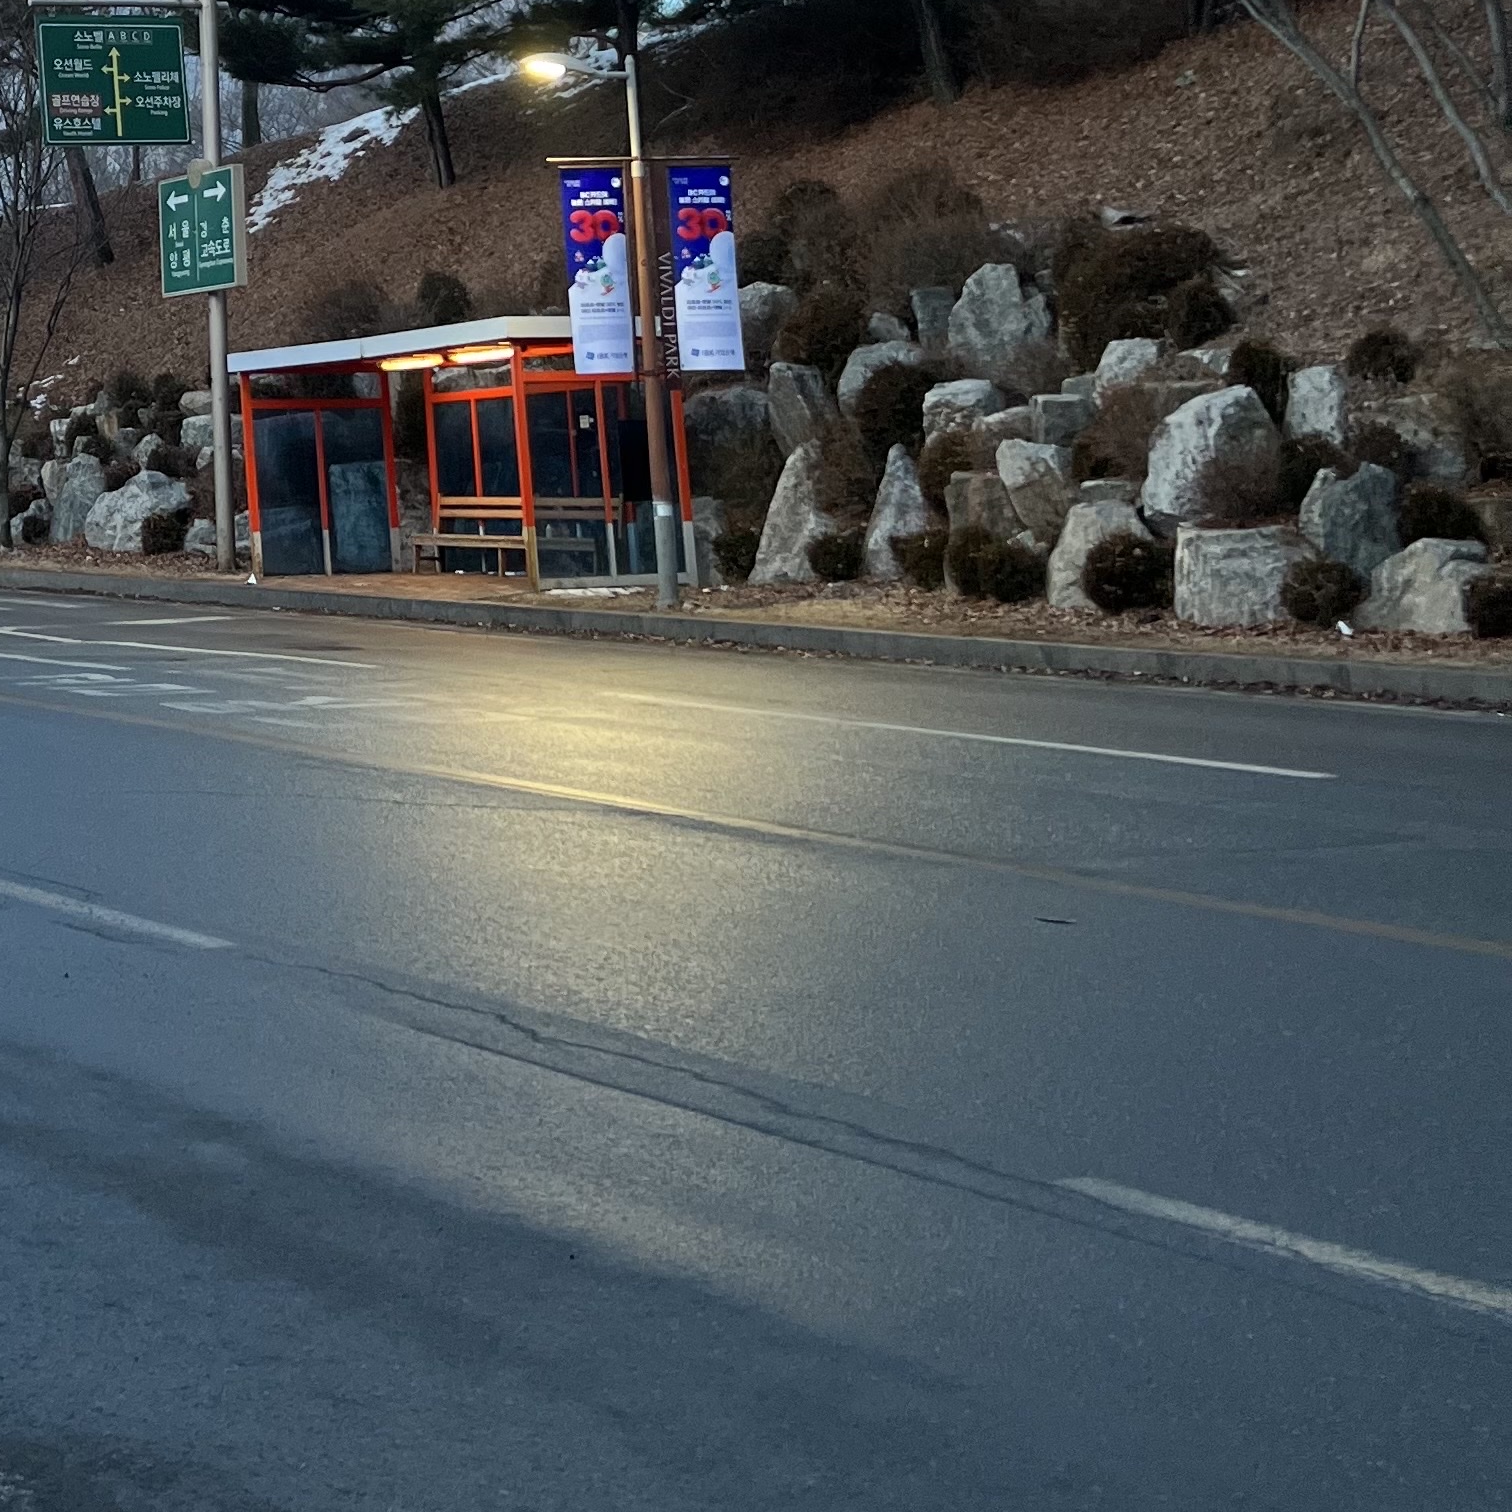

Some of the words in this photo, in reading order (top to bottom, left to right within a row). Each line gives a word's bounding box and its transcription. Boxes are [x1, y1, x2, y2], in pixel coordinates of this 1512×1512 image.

[53, 58, 93, 71] 오션월드
[51, 94, 100, 107] 골프연습장
[135, 96, 181, 109] 오션주차장
[168, 220, 190, 240] 서울
[569, 209, 619, 243] 30
[677, 207, 728, 241] 30
[200, 238, 231, 257] 고속도로
[658, 252, 676, 326] VIVALDI
[663, 333, 680, 379] PARK
